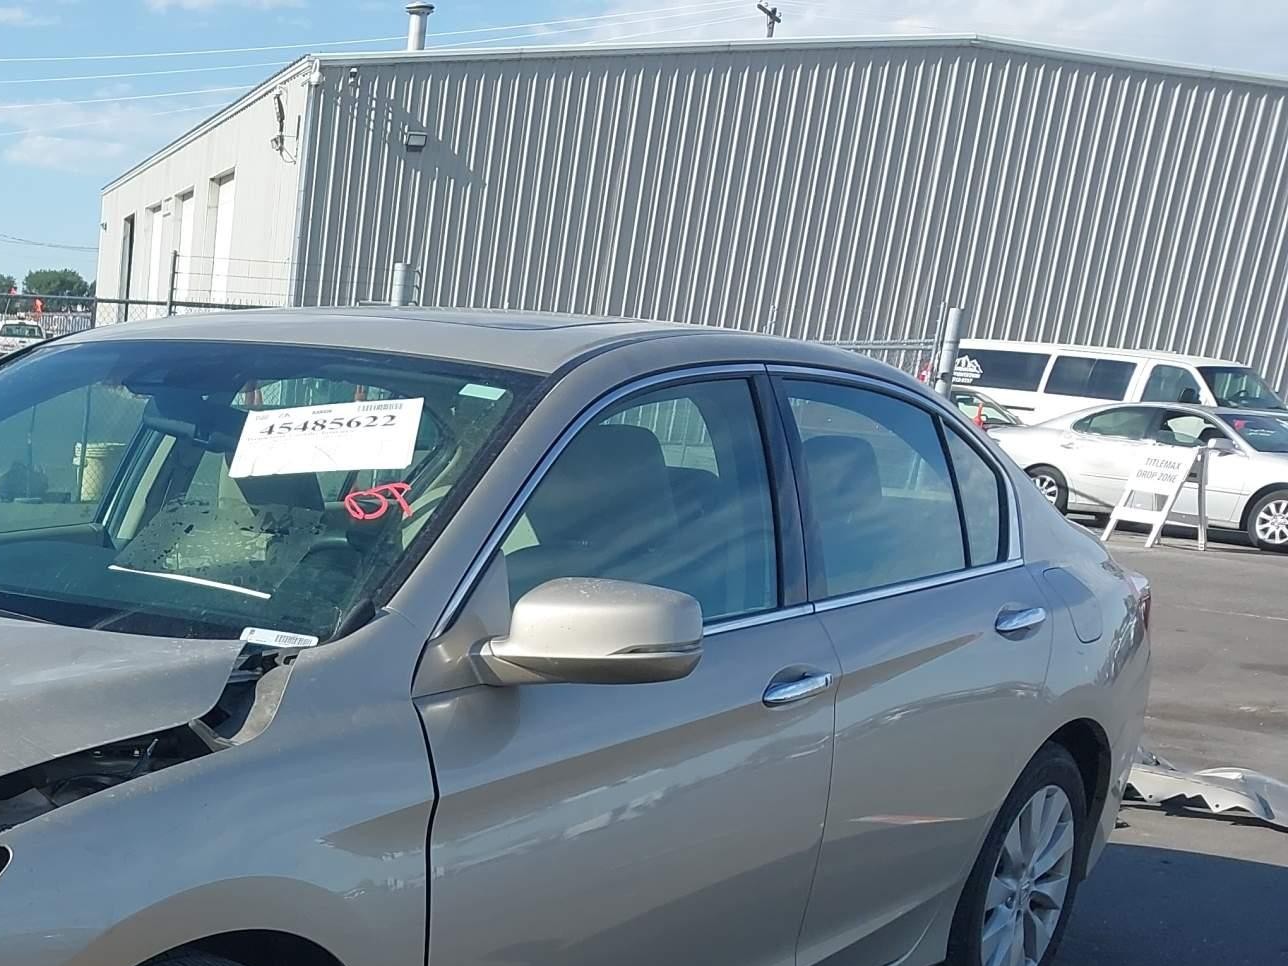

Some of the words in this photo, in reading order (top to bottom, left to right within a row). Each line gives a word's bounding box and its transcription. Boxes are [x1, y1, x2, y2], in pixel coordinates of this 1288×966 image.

[259, 414, 398, 436] 45485622
[1145, 457, 1183, 470] TITLEMAX
[1136, 469, 1158, 480] DROP
[1157, 472, 1180, 484] ZONE
